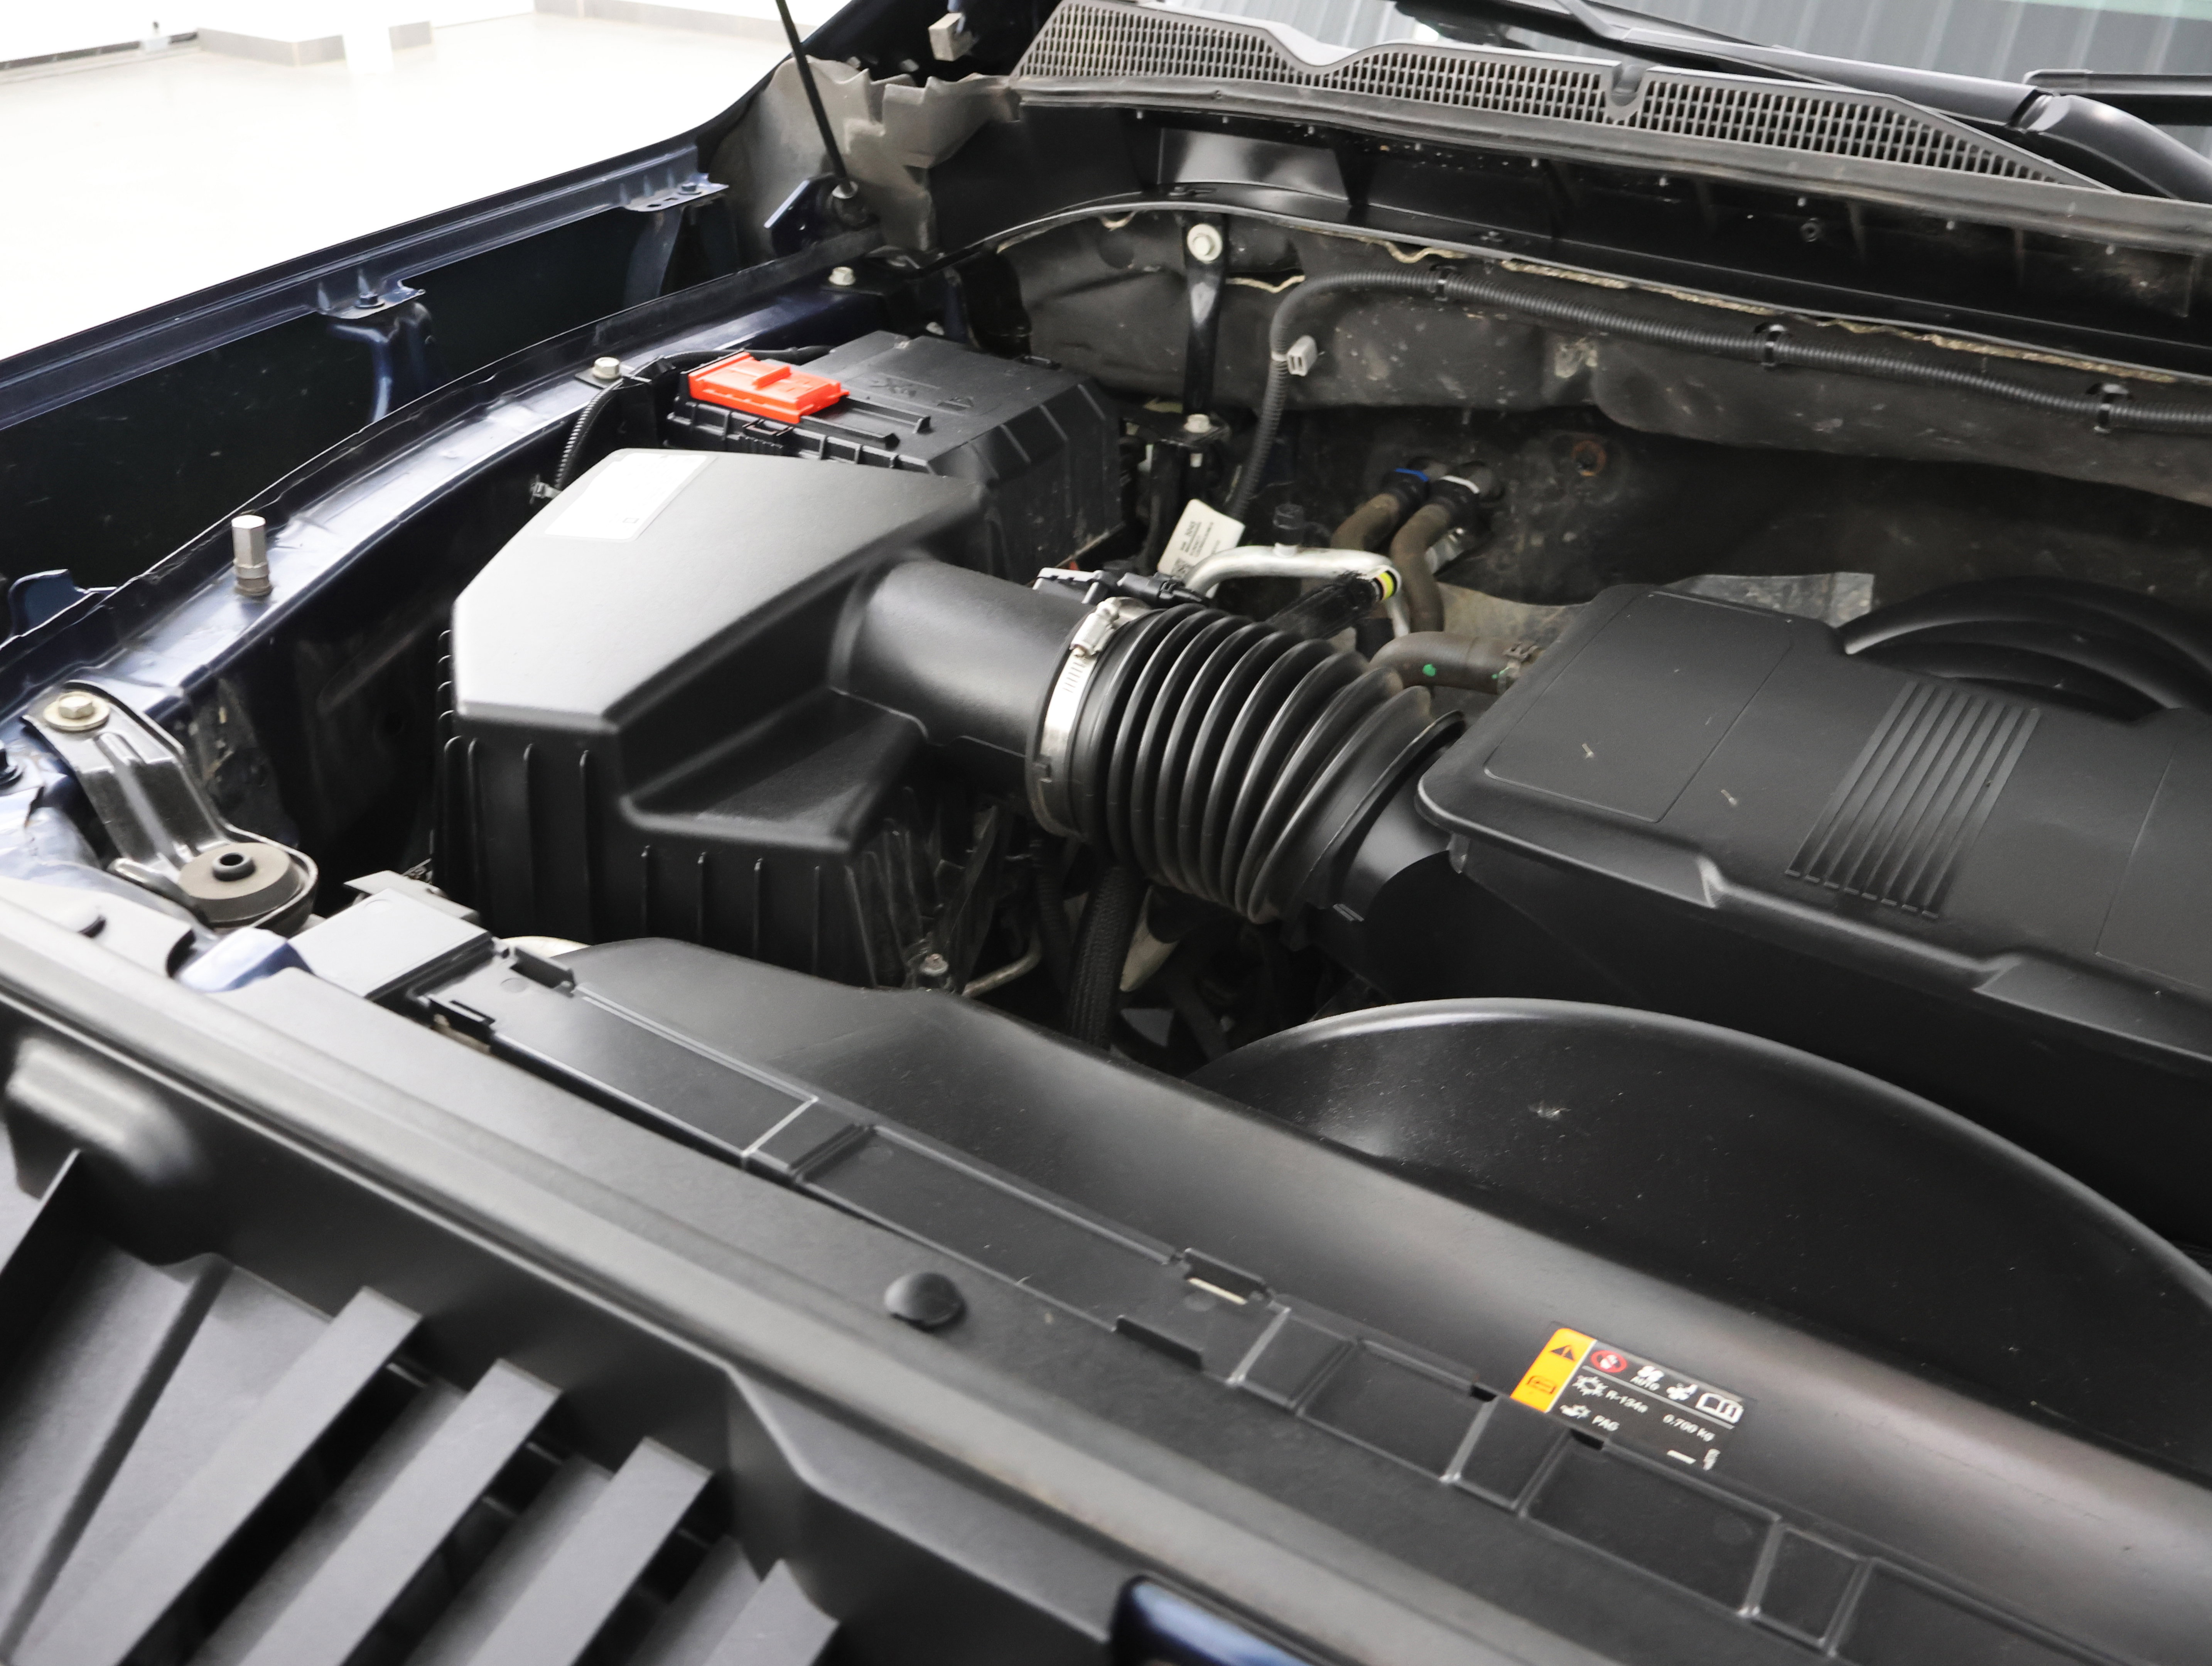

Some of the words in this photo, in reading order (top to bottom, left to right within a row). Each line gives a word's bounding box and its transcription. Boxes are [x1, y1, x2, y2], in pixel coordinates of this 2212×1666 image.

[1592, 1415, 1620, 1432] PAG
[1605, 1390, 1648, 1413] R-134a
[1697, 1428, 1716, 1442] kg
